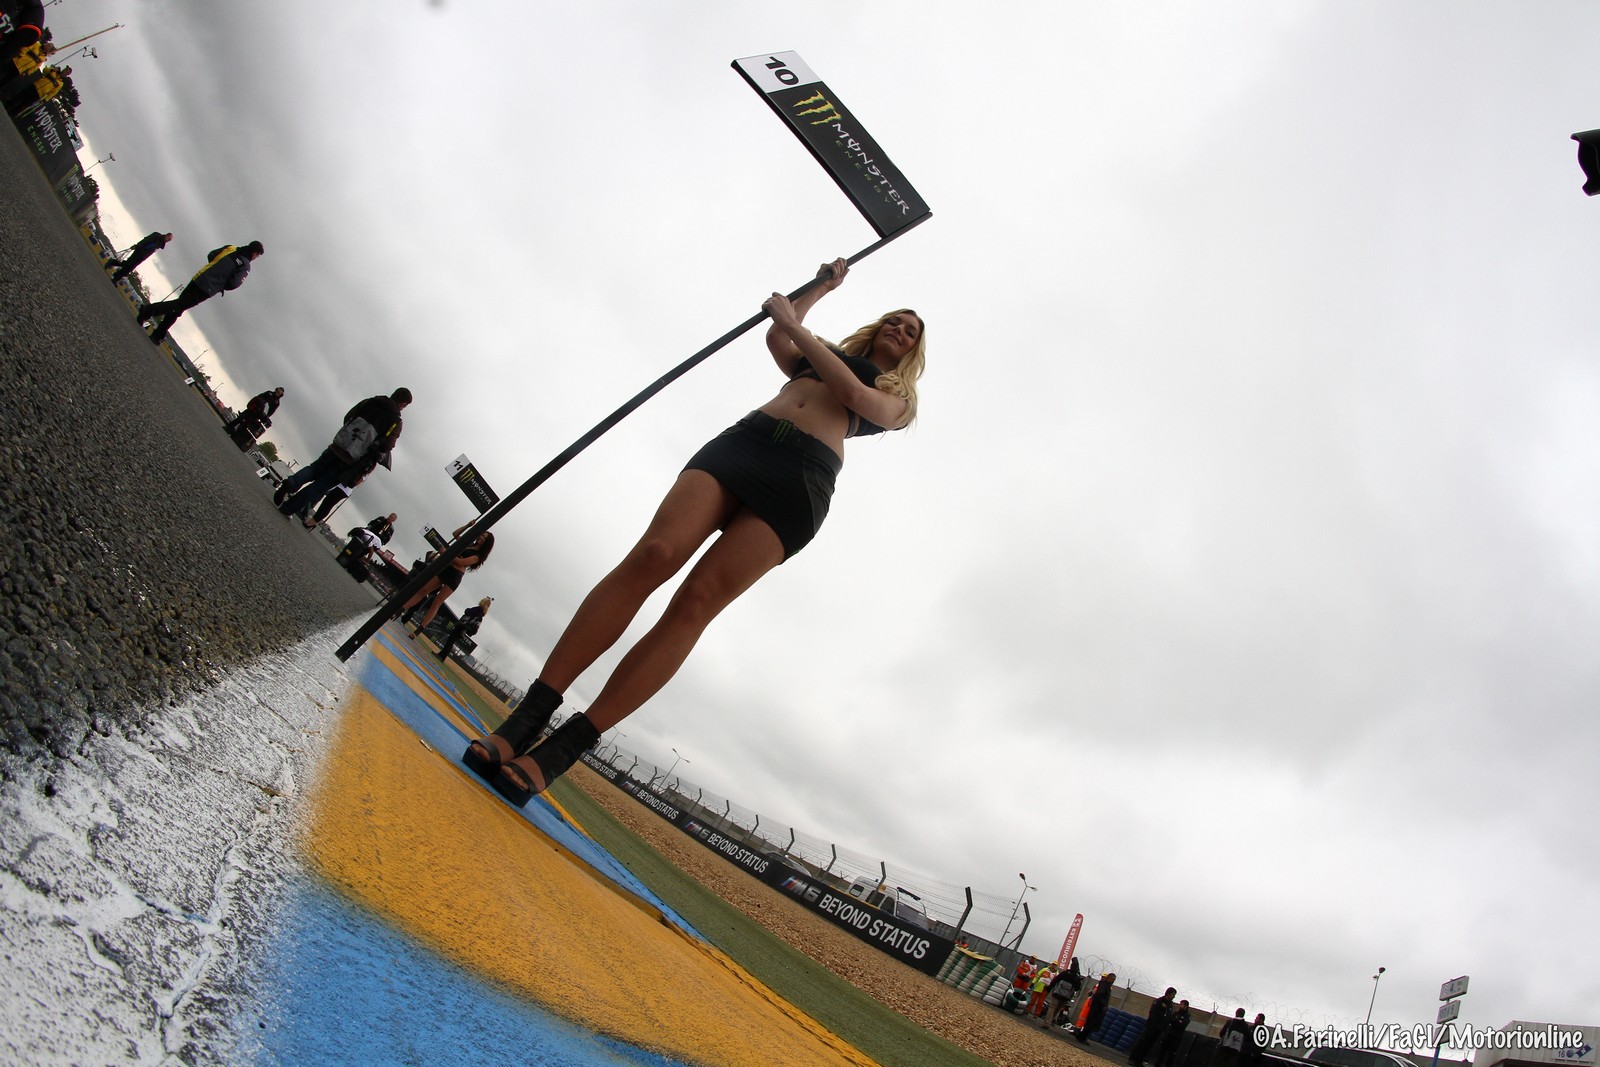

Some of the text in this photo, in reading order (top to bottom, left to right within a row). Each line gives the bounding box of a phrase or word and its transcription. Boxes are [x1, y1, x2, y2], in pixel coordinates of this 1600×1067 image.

[765, 56, 799, 85] 10
[27, 125, 46, 156] ENERGY
[34, 106, 62, 154] MONSTER
[832, 123, 910, 215] MONSTER
[835, 140, 891, 203] ENERGY
[453, 460, 463, 471] 11
[583, 754, 601, 770] BEYOND
[599, 765, 617, 780] STATUS
[637, 789, 659, 808] BEYOND
[656, 802, 679, 820] STATUS
[707, 833, 738, 857] BEYOND
[735, 850, 769, 874] STATUS
[819, 893, 872, 931] BEYOND
[868, 919, 930, 960] STATUS
